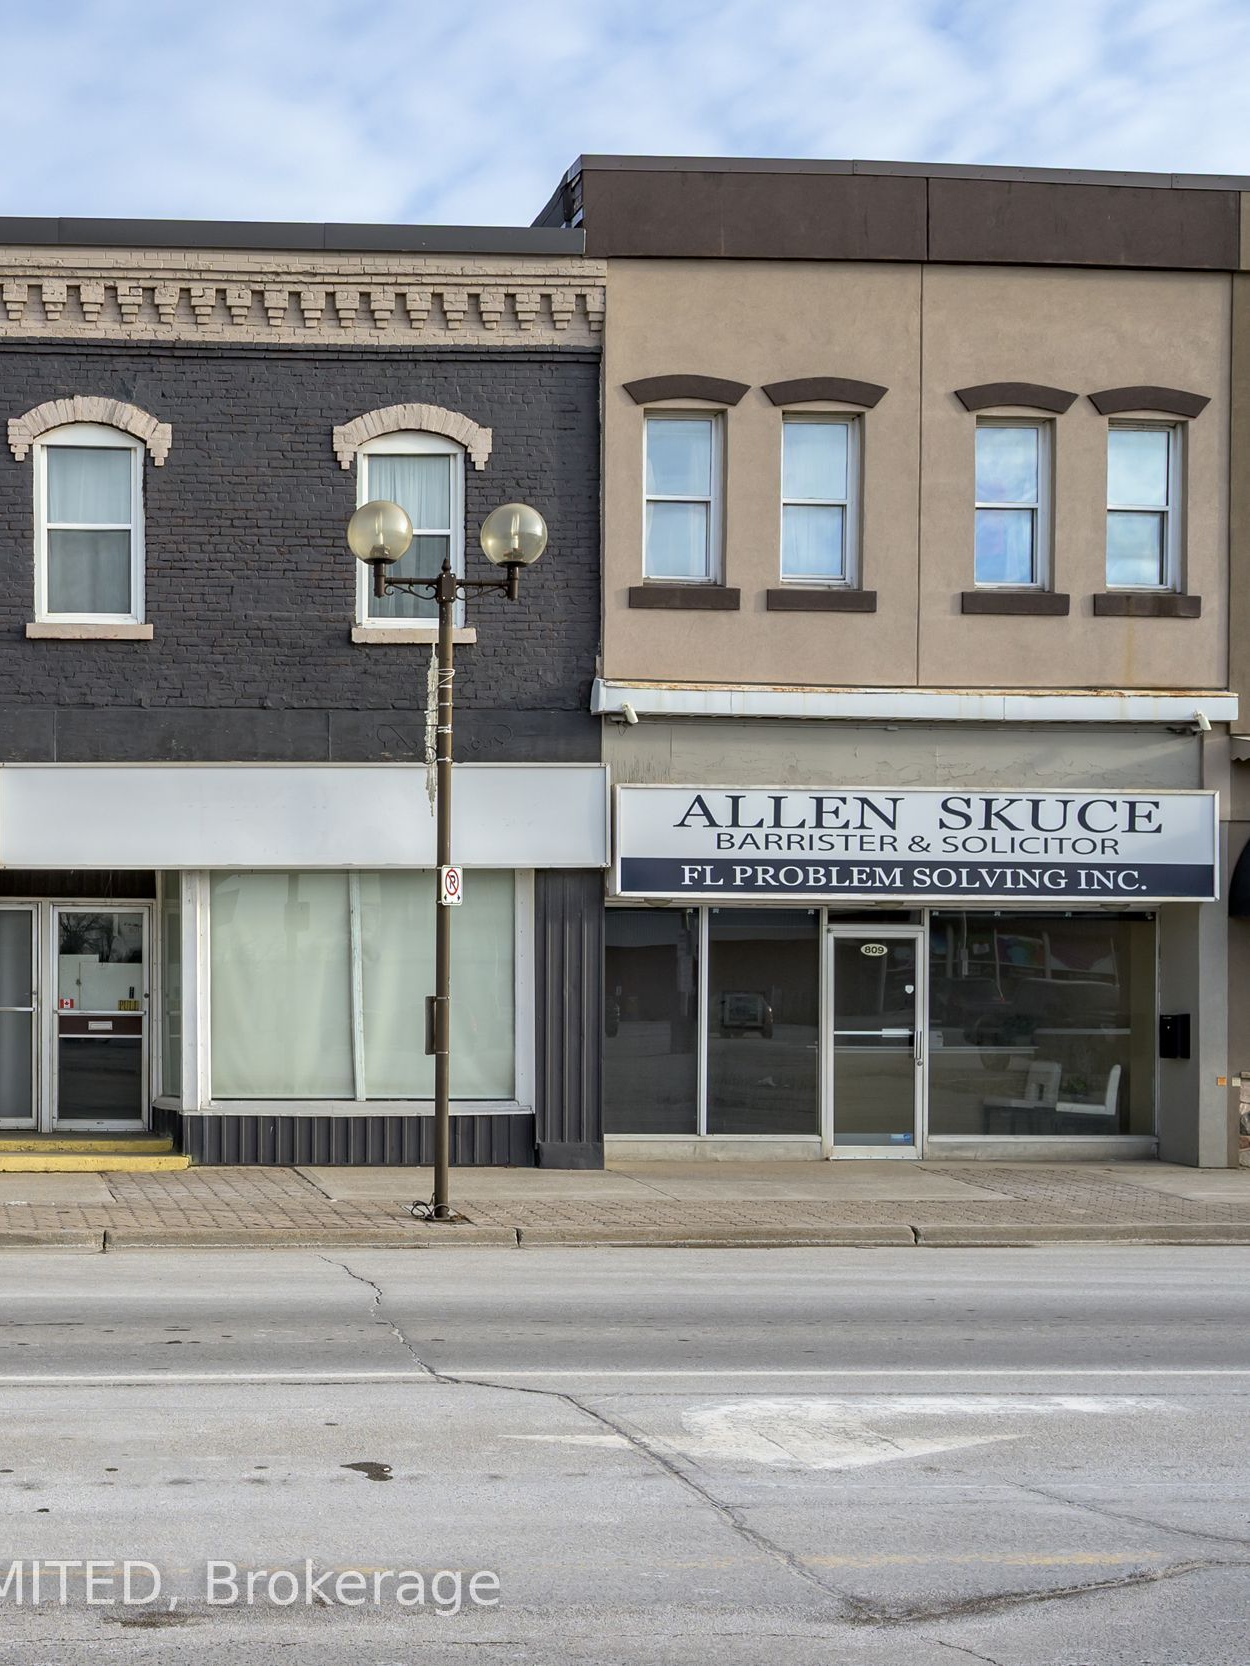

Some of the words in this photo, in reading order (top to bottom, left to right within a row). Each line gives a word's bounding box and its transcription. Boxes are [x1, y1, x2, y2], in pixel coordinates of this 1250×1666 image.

[672, 794, 905, 831] ALLEN
[938, 796, 1163, 834] SKUCE
[716, 832, 898, 852] BARRISTER
[908, 835, 931, 853] &
[942, 836, 1120, 855] SOLICITOR
[681, 865, 724, 885] FL
[732, 865, 904, 887] PROBLEM
[912, 867, 1068, 889] SOLVING
[1077, 869, 1147, 891] INC.
[864, 946, 884, 954] 809
